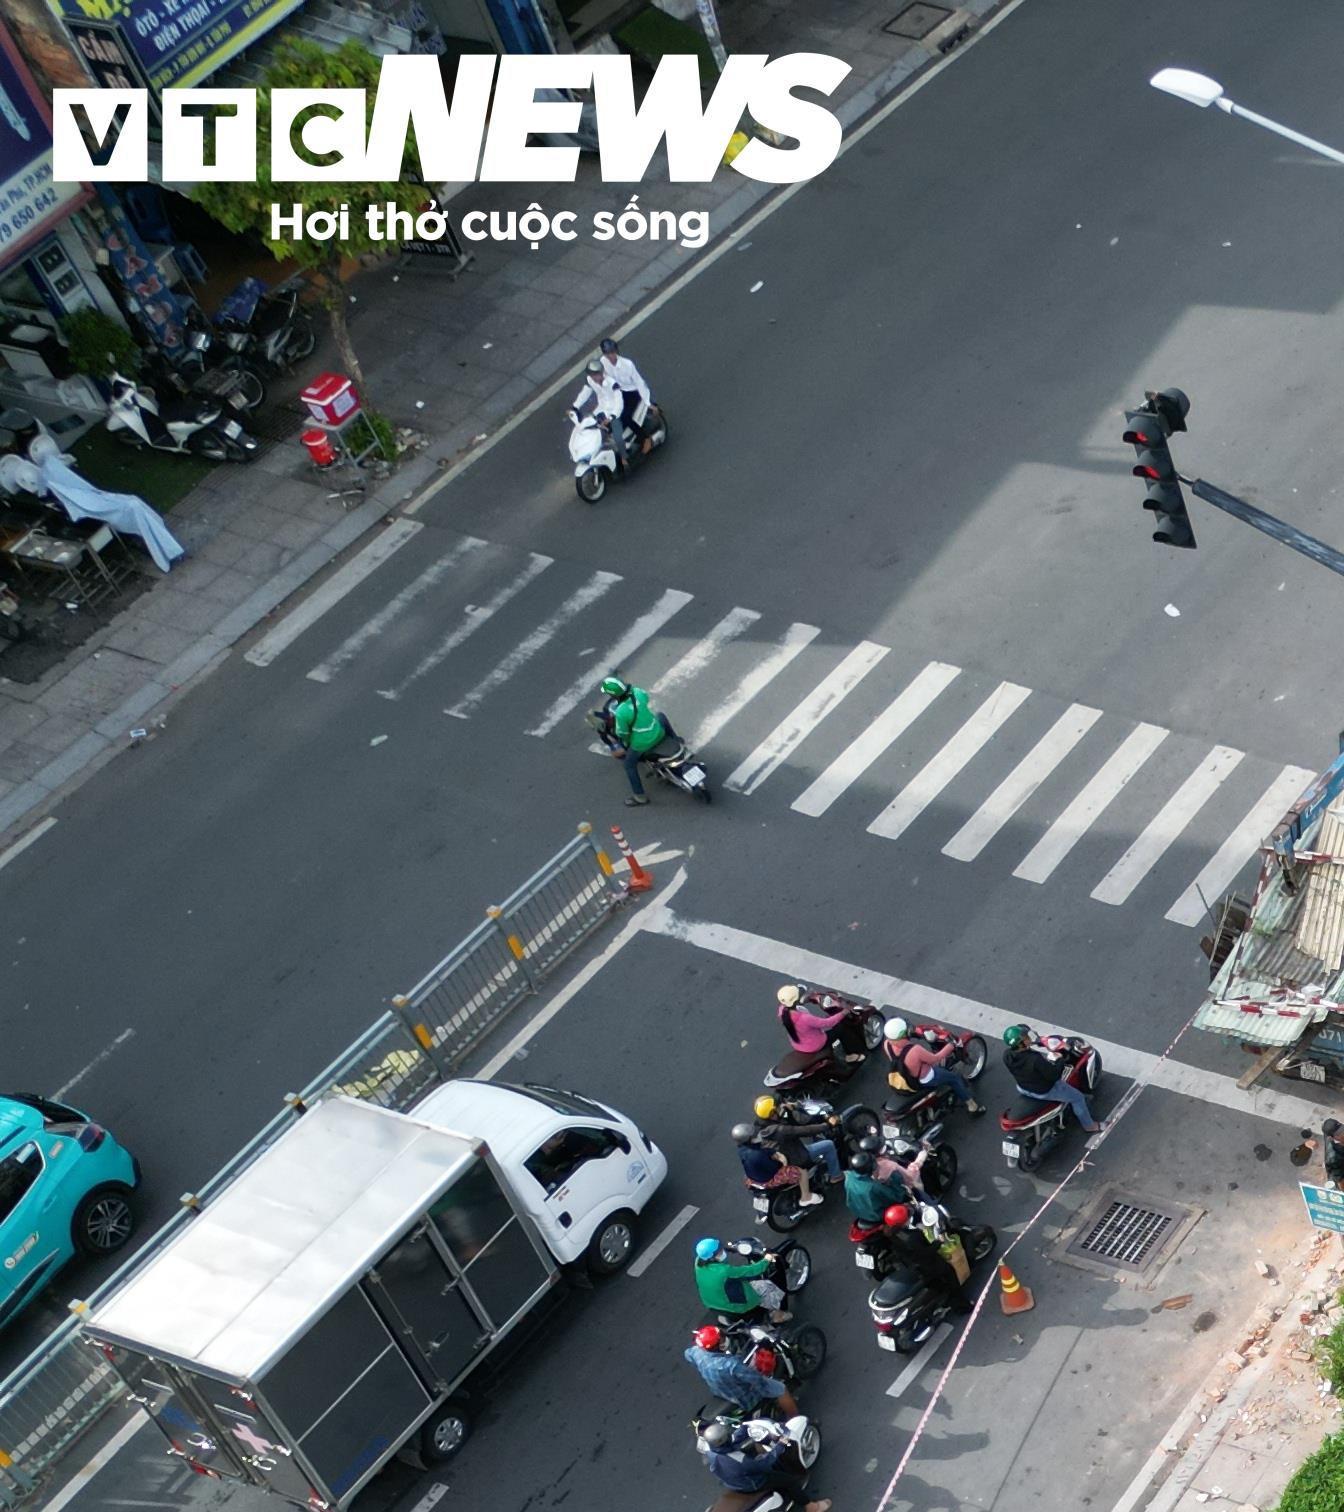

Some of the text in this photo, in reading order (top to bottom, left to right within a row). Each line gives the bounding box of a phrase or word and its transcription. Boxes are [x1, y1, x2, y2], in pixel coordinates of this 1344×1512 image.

[153, 23, 181, 52] ĐIỆN
[12, 204, 36, 228] 650
[36, 187, 59, 211] 642
